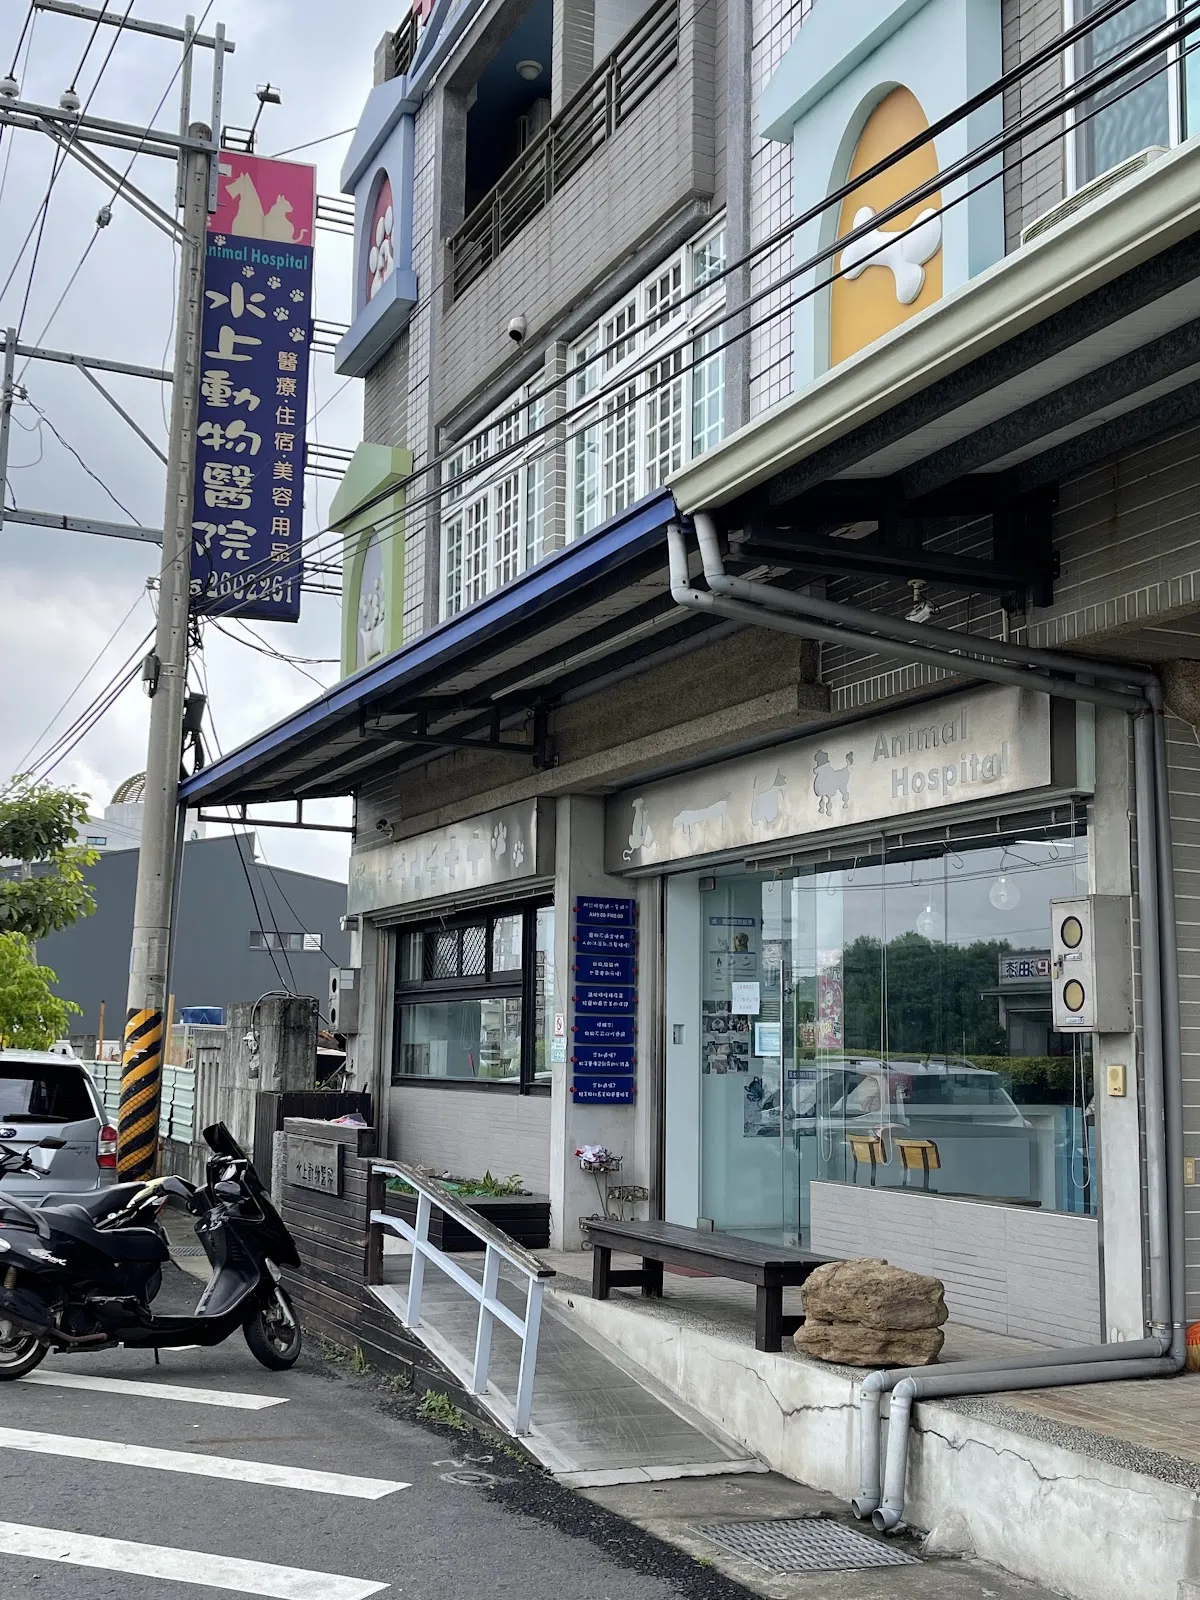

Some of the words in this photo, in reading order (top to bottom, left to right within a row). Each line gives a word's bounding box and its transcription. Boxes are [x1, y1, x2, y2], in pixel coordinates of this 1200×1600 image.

[205, 245, 248, 262] nimal
[251, 248, 308, 270] Hospital
[191, 281, 267, 561] 水上動物醫院
[872, 704, 968, 763] Animal
[891, 740, 1009, 799] Hospital
